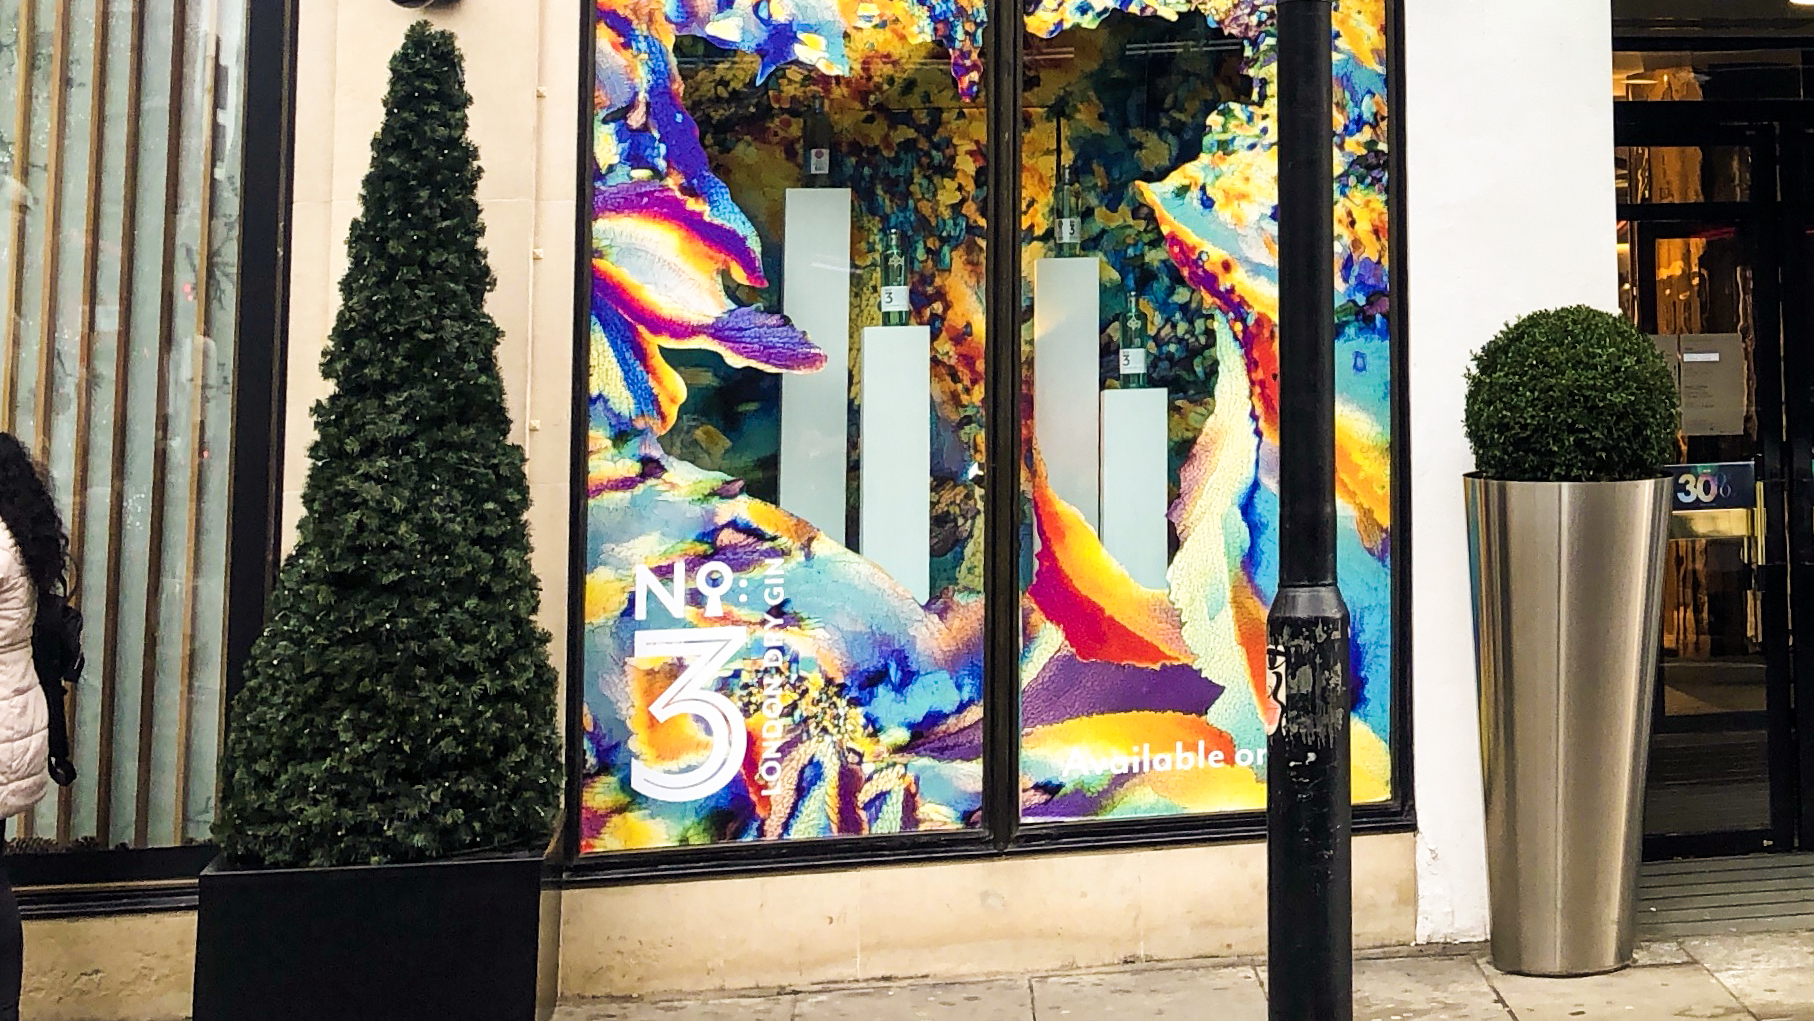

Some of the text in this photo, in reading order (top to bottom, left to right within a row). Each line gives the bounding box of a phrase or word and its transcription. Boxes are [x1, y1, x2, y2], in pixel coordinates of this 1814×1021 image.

[763, 558, 785, 606] GIN
[761, 613, 785, 667] DRY
[631, 627, 747, 802] 3
[761, 676, 785, 795] LONDON
[1062, 739, 1224, 778] Available
